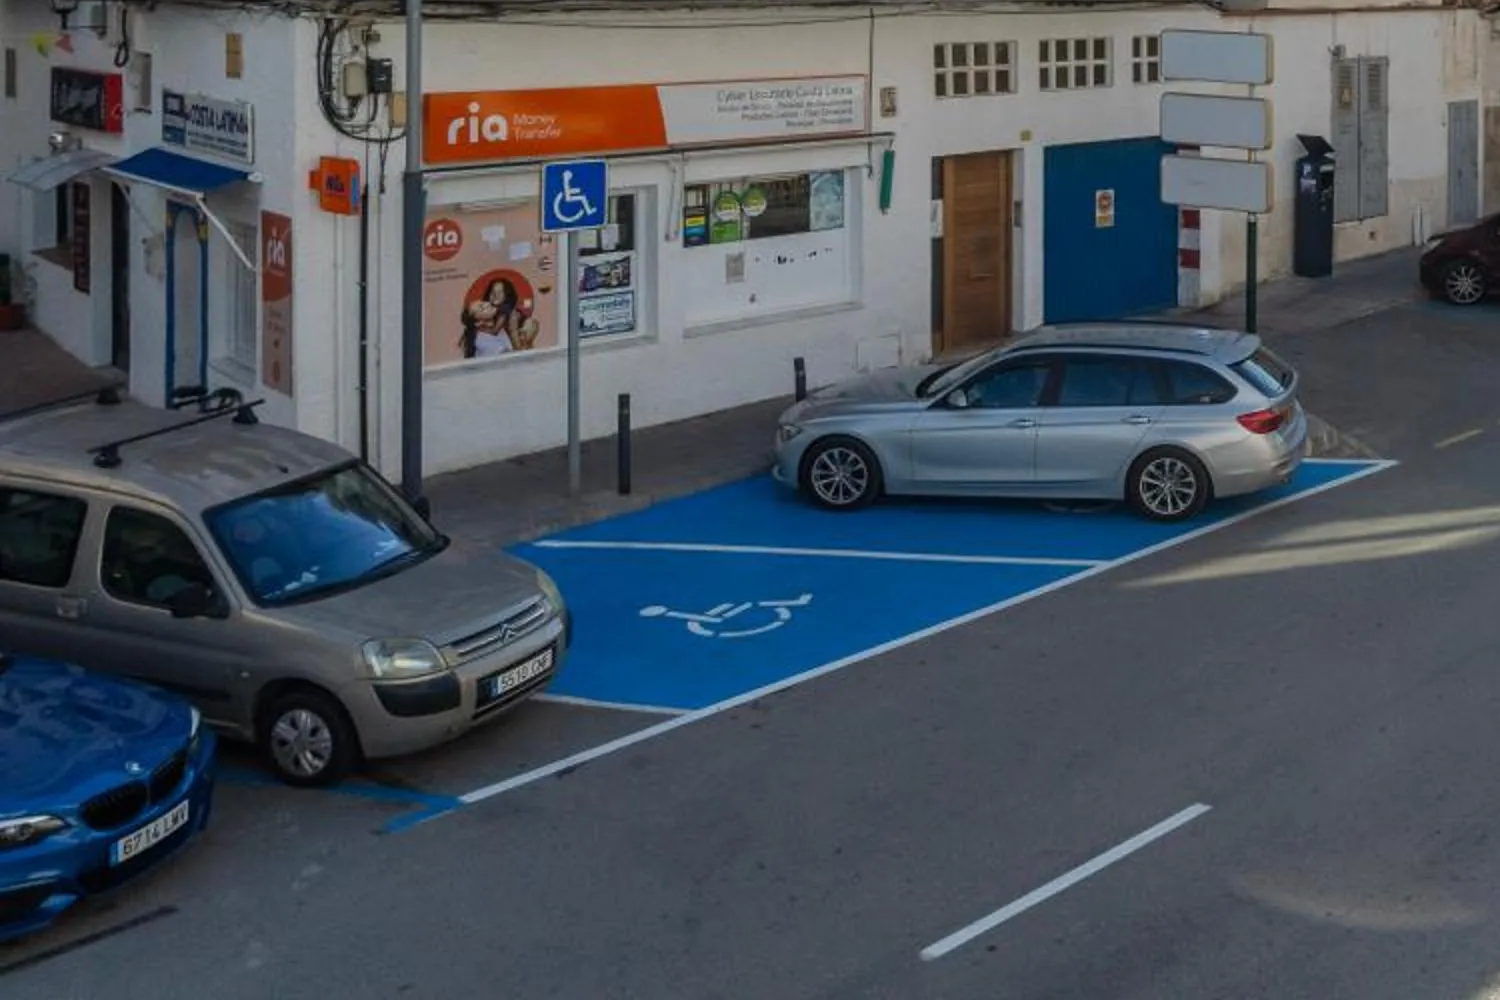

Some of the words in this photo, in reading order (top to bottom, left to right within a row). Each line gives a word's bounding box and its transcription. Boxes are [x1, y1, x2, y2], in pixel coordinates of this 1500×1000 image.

[447, 101, 509, 145] ria
[513, 113, 556, 127] Money
[513, 124, 562, 141] Transfer
[426, 225, 458, 247] ria
[266, 227, 286, 268] ria
